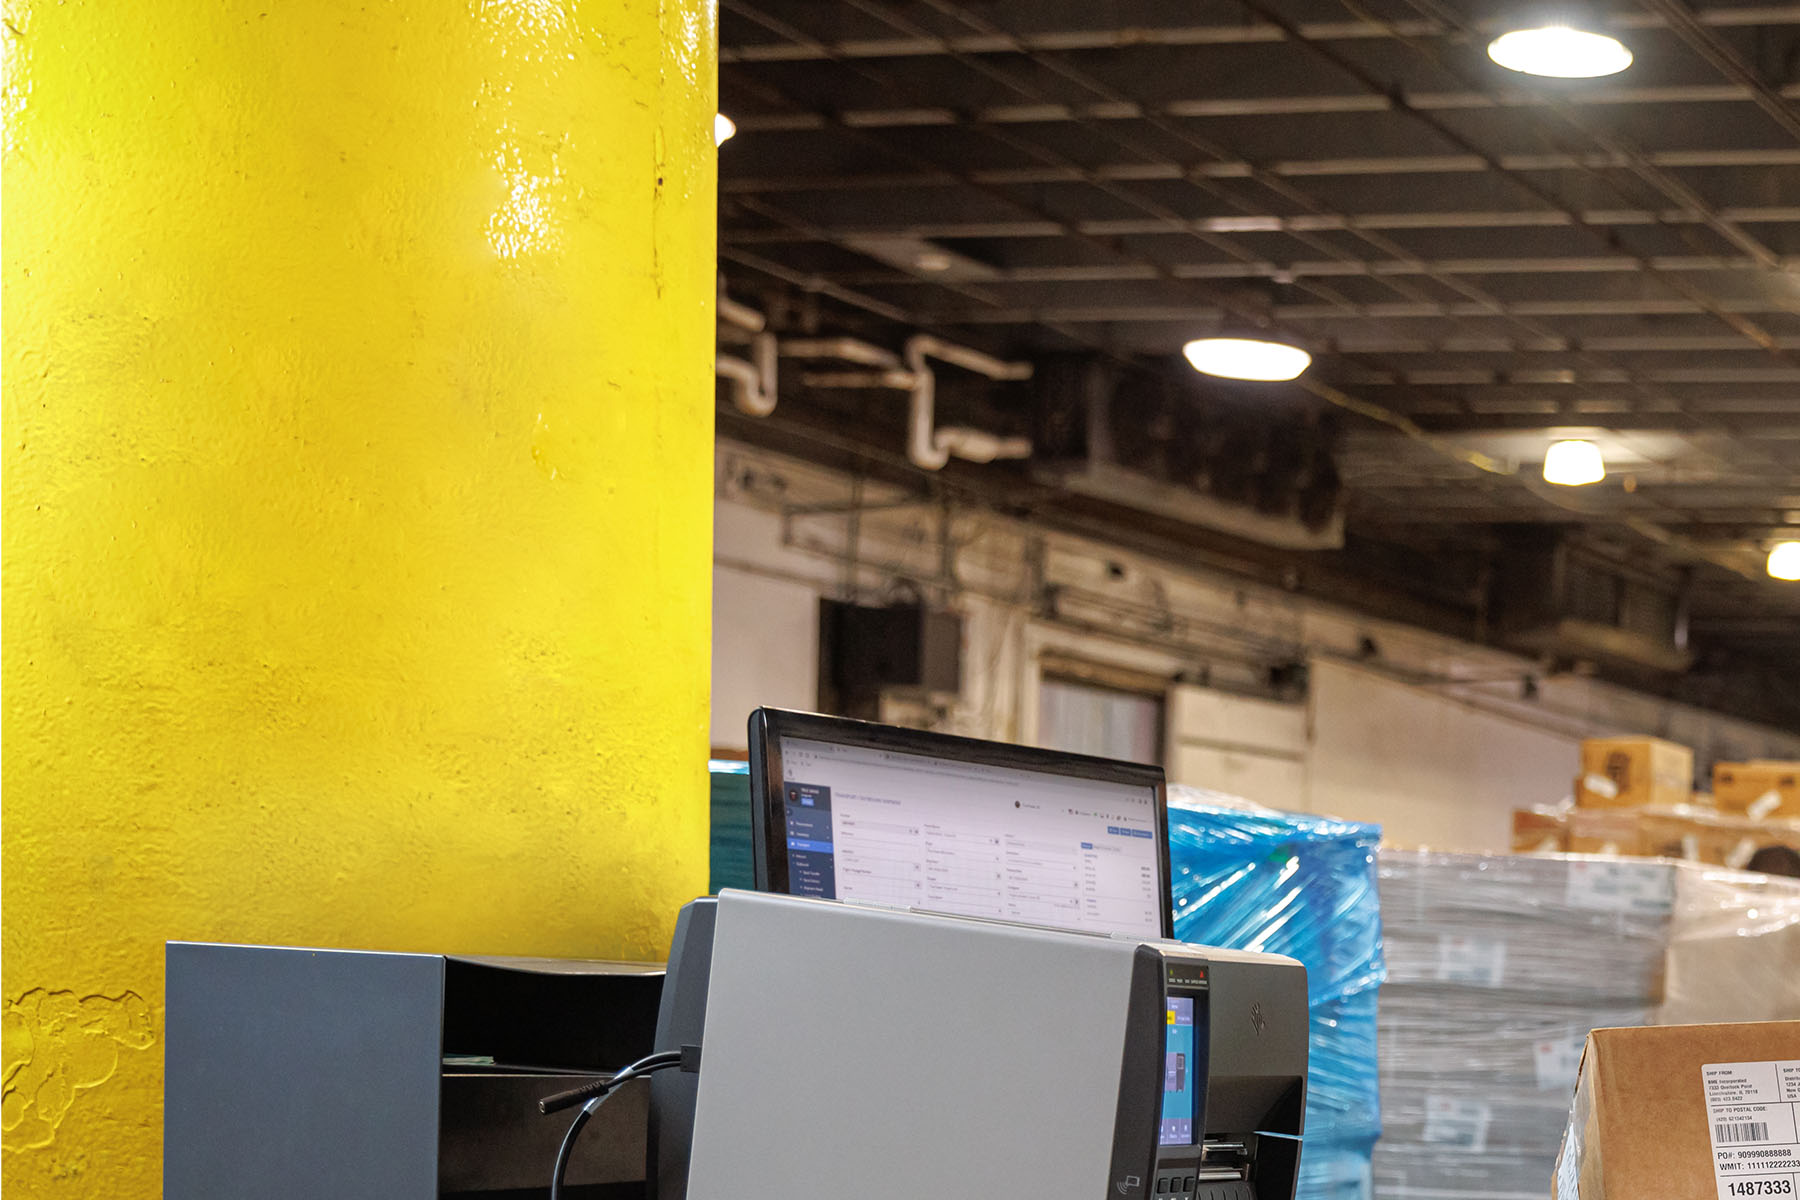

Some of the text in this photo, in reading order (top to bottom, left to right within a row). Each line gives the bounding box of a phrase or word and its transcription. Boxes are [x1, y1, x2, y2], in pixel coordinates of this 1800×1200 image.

[1717, 1152, 1735, 1160] PO#:
[1720, 1163, 1744, 1171] WMIT:
[1728, 1180, 1791, 1196] 1487333
